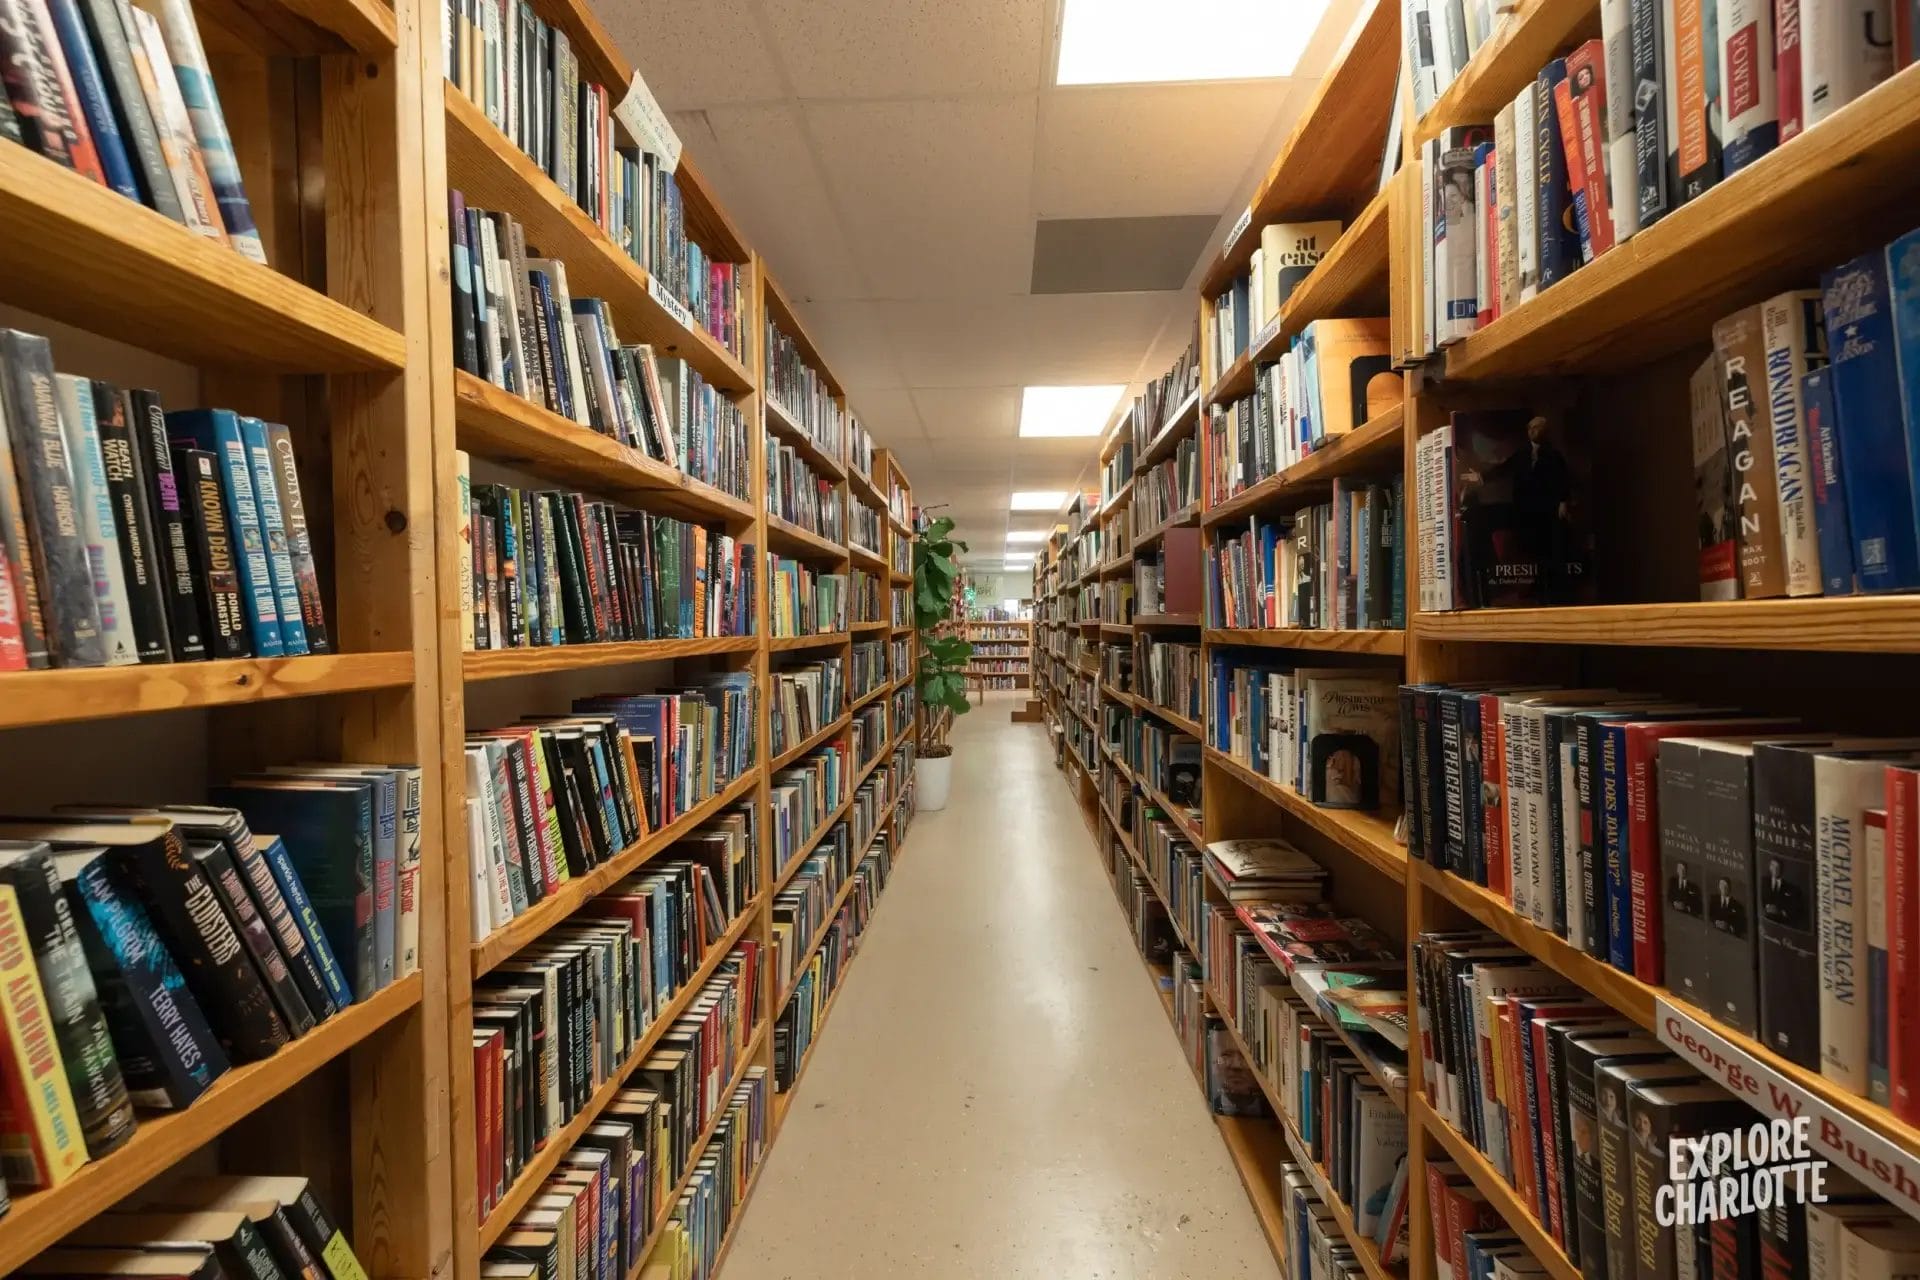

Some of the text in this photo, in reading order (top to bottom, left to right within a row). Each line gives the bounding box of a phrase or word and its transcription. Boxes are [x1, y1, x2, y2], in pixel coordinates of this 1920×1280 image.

[1681, 28, 1704, 170] THE OVAL OFFICE
[1732, 30, 1749, 112] POWER
[1538, 78, 1551, 188] SPIN CYCLE
[1636, 117, 1645, 174] MORRIS
[1645, 119, 1656, 157] DICK
[1295, 235, 1317, 251] at
[538, 320, 547, 341] JAMES
[654, 283, 688, 323] Mystery
[1725, 356, 1760, 536] REAGAN
[1768, 349, 1803, 503] RONALD REAGAN
[30, 373, 76, 537] SAVANNAH BLUE HARRISON
[102, 438, 123, 482] WATCH
[117, 439, 134, 479] DEATH
[230, 465, 251, 499] CHRISTIE
[1819, 426, 1836, 485] Art Buchwald
[158, 472, 180, 512] DEATH
[235, 501, 254, 525] CAPER
[256, 468, 280, 502] CHRISTIE
[276, 438, 310, 556] CAROLYN HART
[122, 493, 146, 585] CYNTHIA HARROD-EAGLES
[168, 522, 186, 548] CYNTHIA
[199, 480, 232, 570] KNOWN DEAD
[263, 503, 284, 528] CAPER
[523, 502, 532, 540] GERALD
[247, 553, 270, 586] CAROLYN
[273, 555, 297, 586] CAROLYN
[509, 581, 517, 603] TRIAL
[604, 543, 616, 586] JOHANSEN
[1495, 562, 1582, 577] PRESITS
[215, 593, 231, 637] HARSTAD
[227, 592, 242, 631] DONALD
[1511, 715, 1523, 738] WHAT
[1511, 743, 1524, 764] SAW
[1529, 718, 1541, 742] WHAT
[1443, 723, 1463, 840] THE PEACEMAKER
[1512, 777, 1525, 791] THE
[1530, 748, 1542, 767] SAW
[1532, 781, 1543, 796] THE
[1577, 725, 1594, 906] KILLING REAGAN BILL O'REILLY
[1605, 777, 1619, 847] DOES JOAN
[1634, 761, 1647, 822] MY FATHER
[380, 815, 396, 840] Healy
[398, 777, 421, 915] Jeremiah Healy Foursome
[488, 800, 499, 842] JOHANSEN
[498, 875, 507, 888] THE
[516, 760, 541, 884] IRIS JOHANSEN PERSUASION
[532, 769, 547, 824] JOHANSEN
[541, 826, 558, 884] QUICKSAND
[549, 815, 568, 875] JOHANSEN
[1510, 796, 1523, 879] PEGGY NOONAN
[1528, 801, 1540, 888] PEGGY NOONAN
[1754, 812, 1813, 836] REAGAN
[1820, 816, 1830, 835] ON
[1820, 837, 1831, 862] THE
[40, 857, 64, 895] THE
[53, 897, 75, 937] GIRL
[276, 853, 294, 882] sparkle
[301, 906, 313, 924] the
[1631, 870, 1647, 944] RON REAGAN
[1821, 865, 1832, 917] OUTSIDE
[1831, 814, 1855, 1006] MICHAEL REAGAN
[88, 876, 112, 903] AM
[105, 903, 146, 966] PILGRIM
[183, 874, 241, 966] THE CLOISTERS
[1822, 919, 1833, 976] LOOKING
[42, 924, 85, 1025] THE TRAIN
[11, 973, 56, 1081] ALUMINIUM
[91, 1020, 114, 1070] PAULA
[148, 983, 202, 1070] TERRY HAYES
[81, 1044, 111, 1111] HAWKINS
[1664, 1016, 1920, 1204] George Bush
[1542, 1131, 1556, 1175] GEORGE
[1600, 1126, 1624, 1239] LAURA BUSH
[1634, 1152, 1659, 1270] LAURA BUSH
